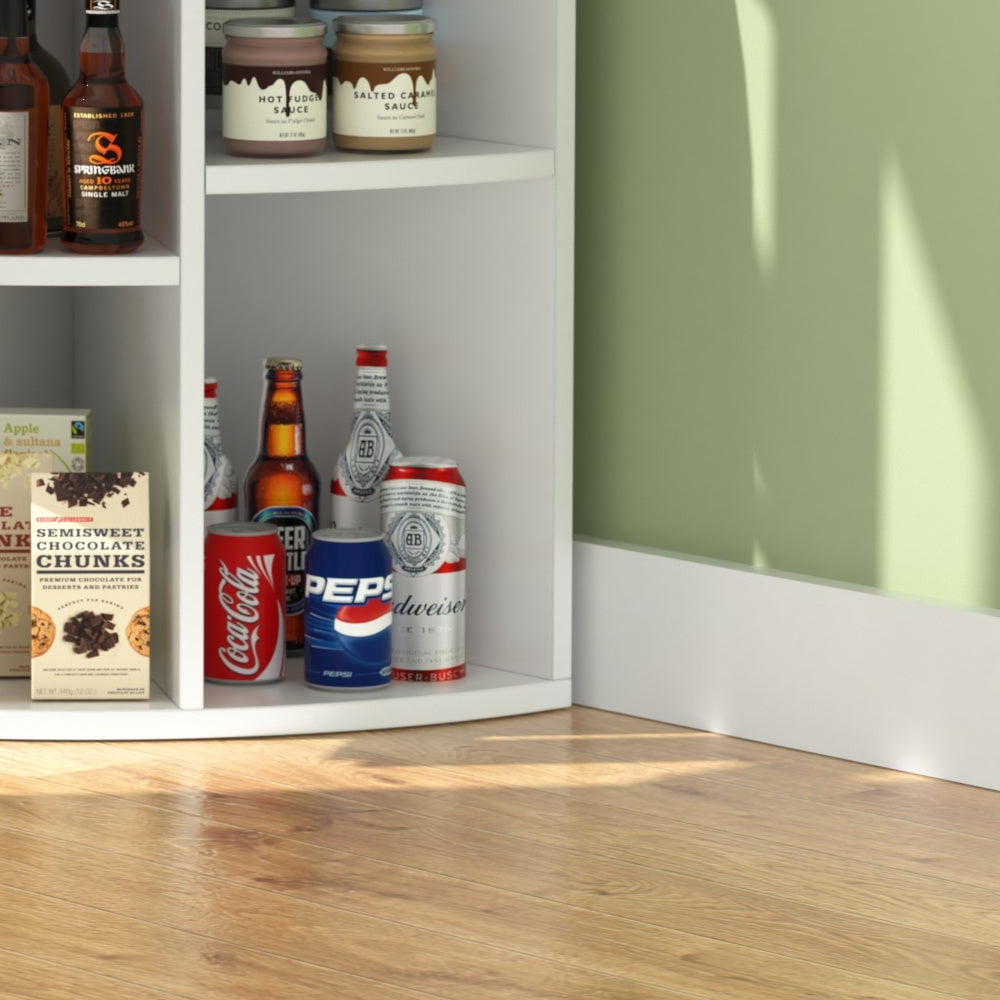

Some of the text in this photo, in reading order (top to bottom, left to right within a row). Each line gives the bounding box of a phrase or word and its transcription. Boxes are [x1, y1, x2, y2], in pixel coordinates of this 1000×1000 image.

[354, 91, 395, 100] SALTED
[273, 105, 308, 114] SAUCE
[384, 102, 419, 110] SAUCE
[73, 163, 136, 176] SPRINGBANK
[97, 176, 113, 185] 10
[81, 190, 108, 198] SINGLE
[3, 423, 40, 436] Apple
[16, 436, 61, 447] sultana
[36, 528, 145, 538] SEMISWEET
[36, 541, 145, 550] CHOCOLATE
[36, 554, 145, 568] CHUNKS
[305, 573, 392, 604] PEPS
[392, 594, 466, 617] dweiser
[323, 670, 352, 678] PEPSI
